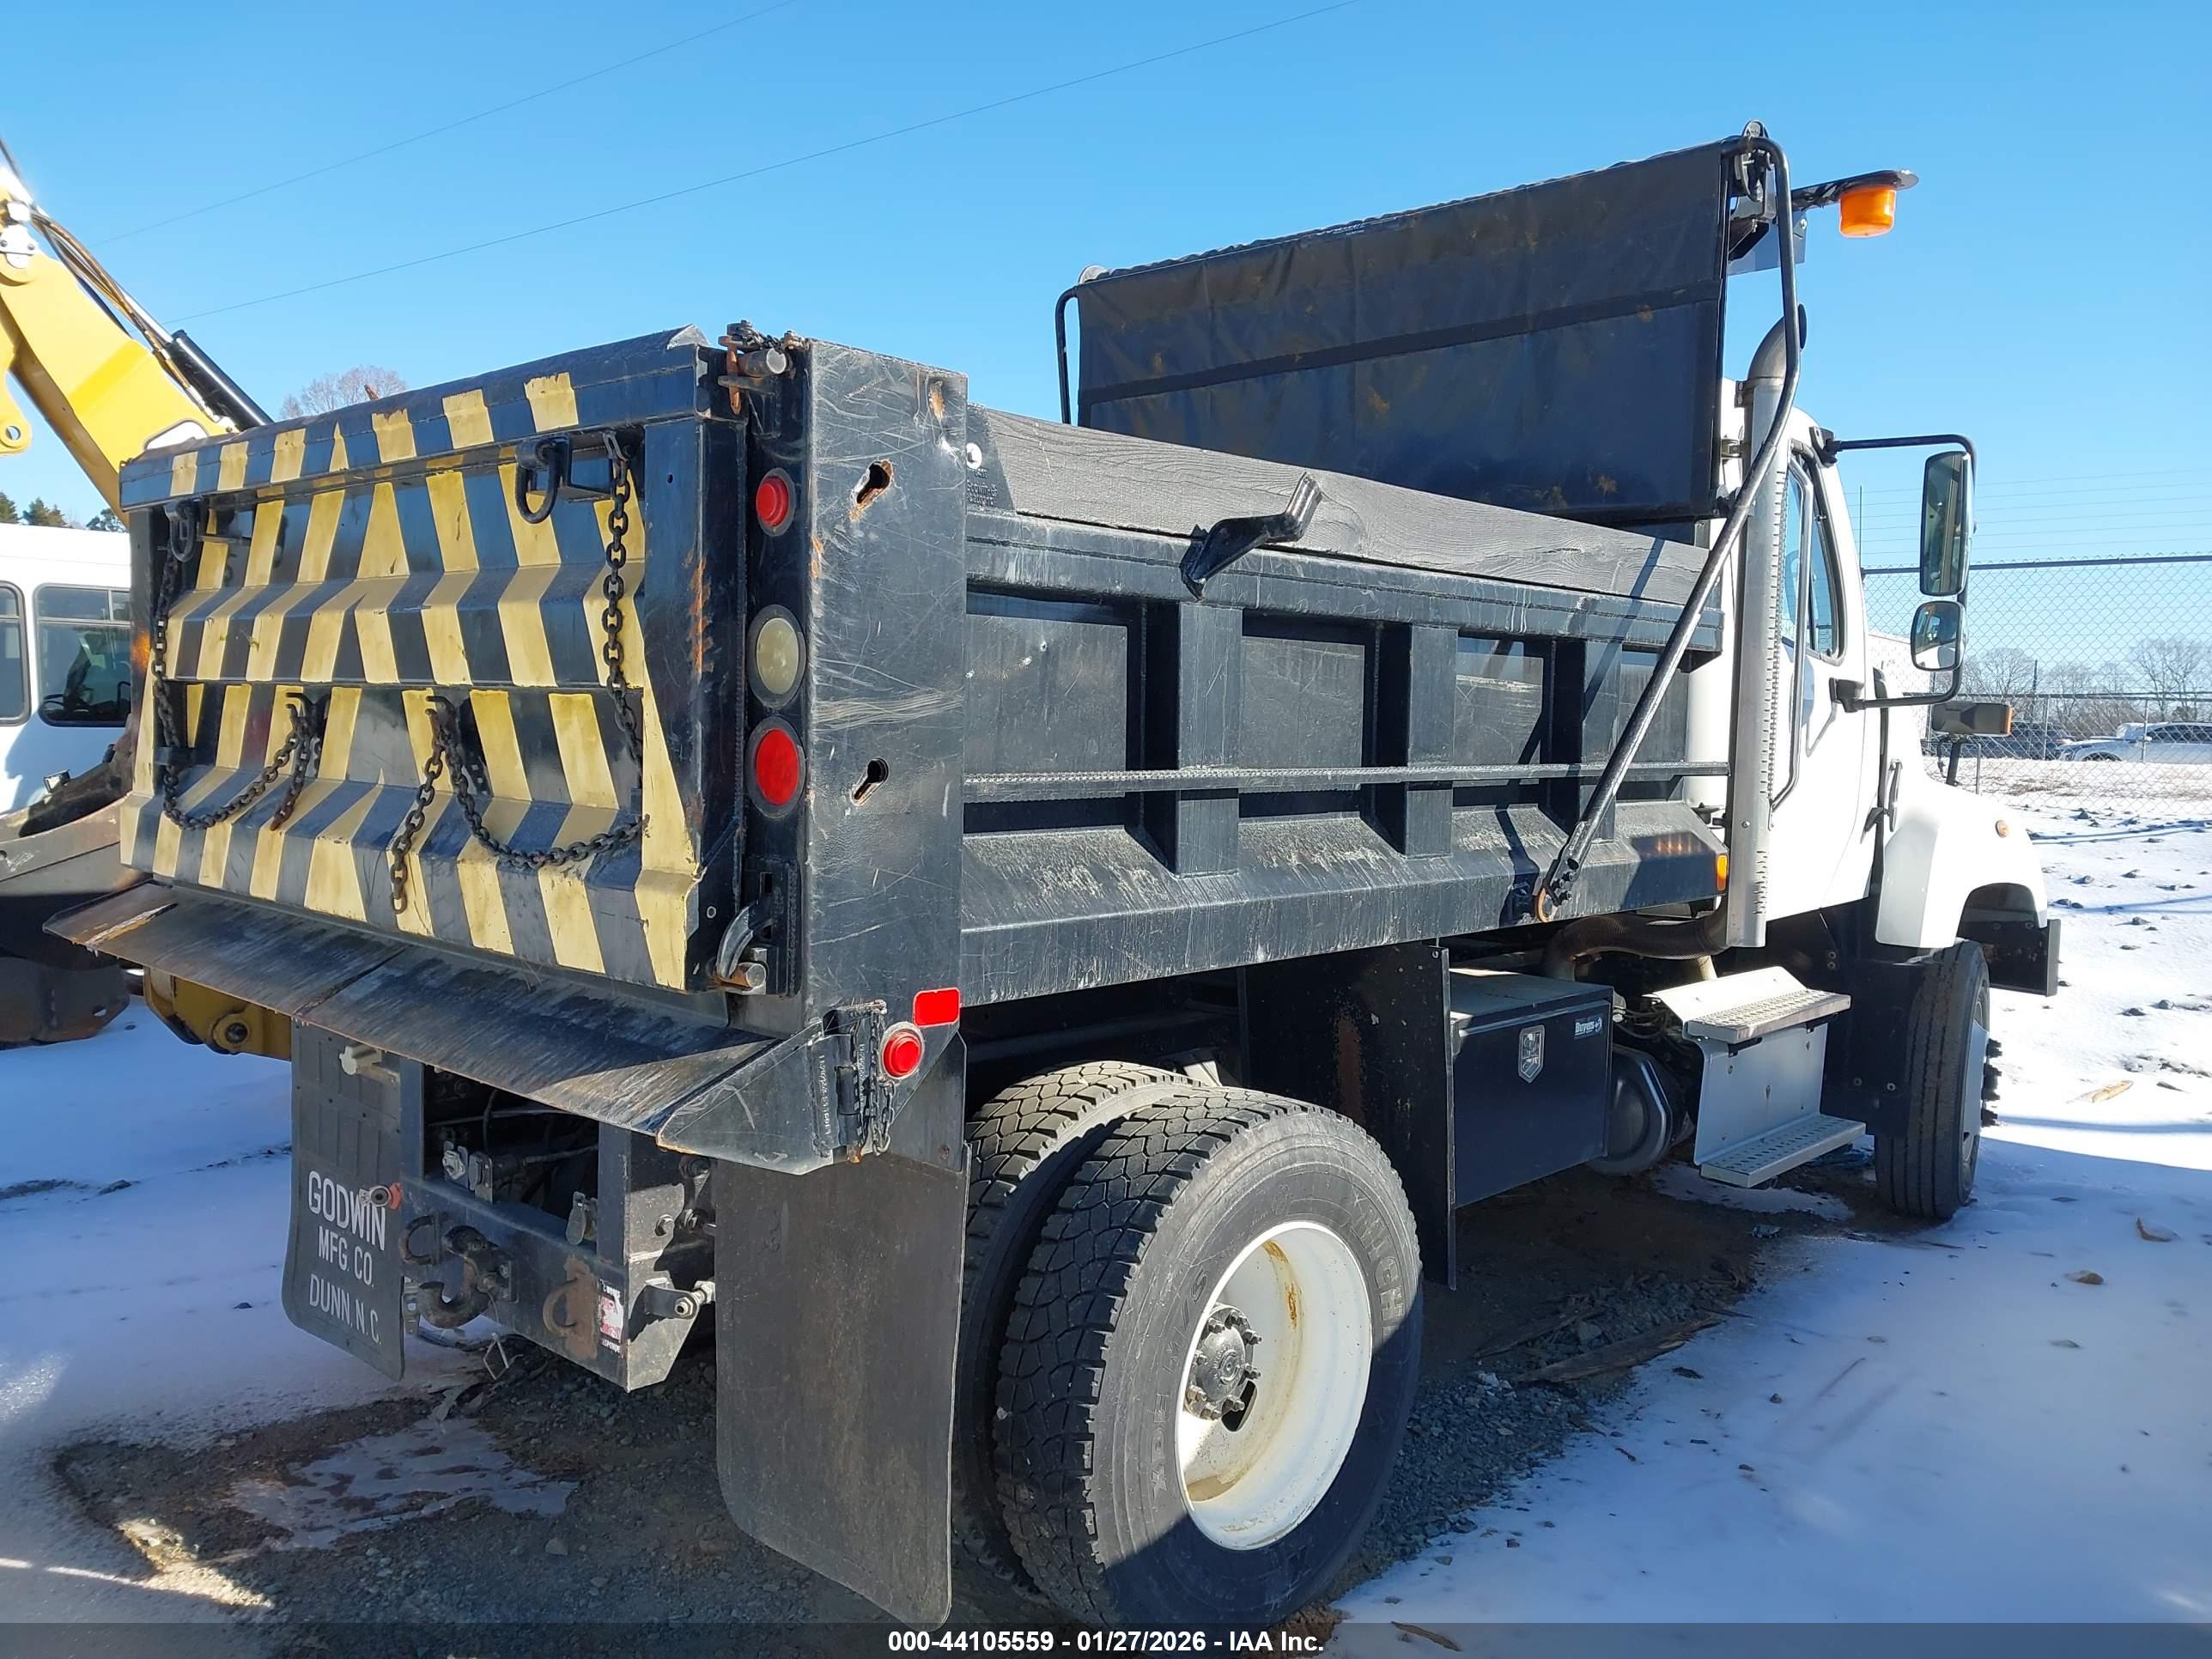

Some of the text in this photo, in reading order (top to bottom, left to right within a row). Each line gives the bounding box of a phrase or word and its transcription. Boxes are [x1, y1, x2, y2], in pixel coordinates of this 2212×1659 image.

[308, 1170, 386, 1251] GODWIN
[319, 1225, 374, 1288] MFG. CO.
